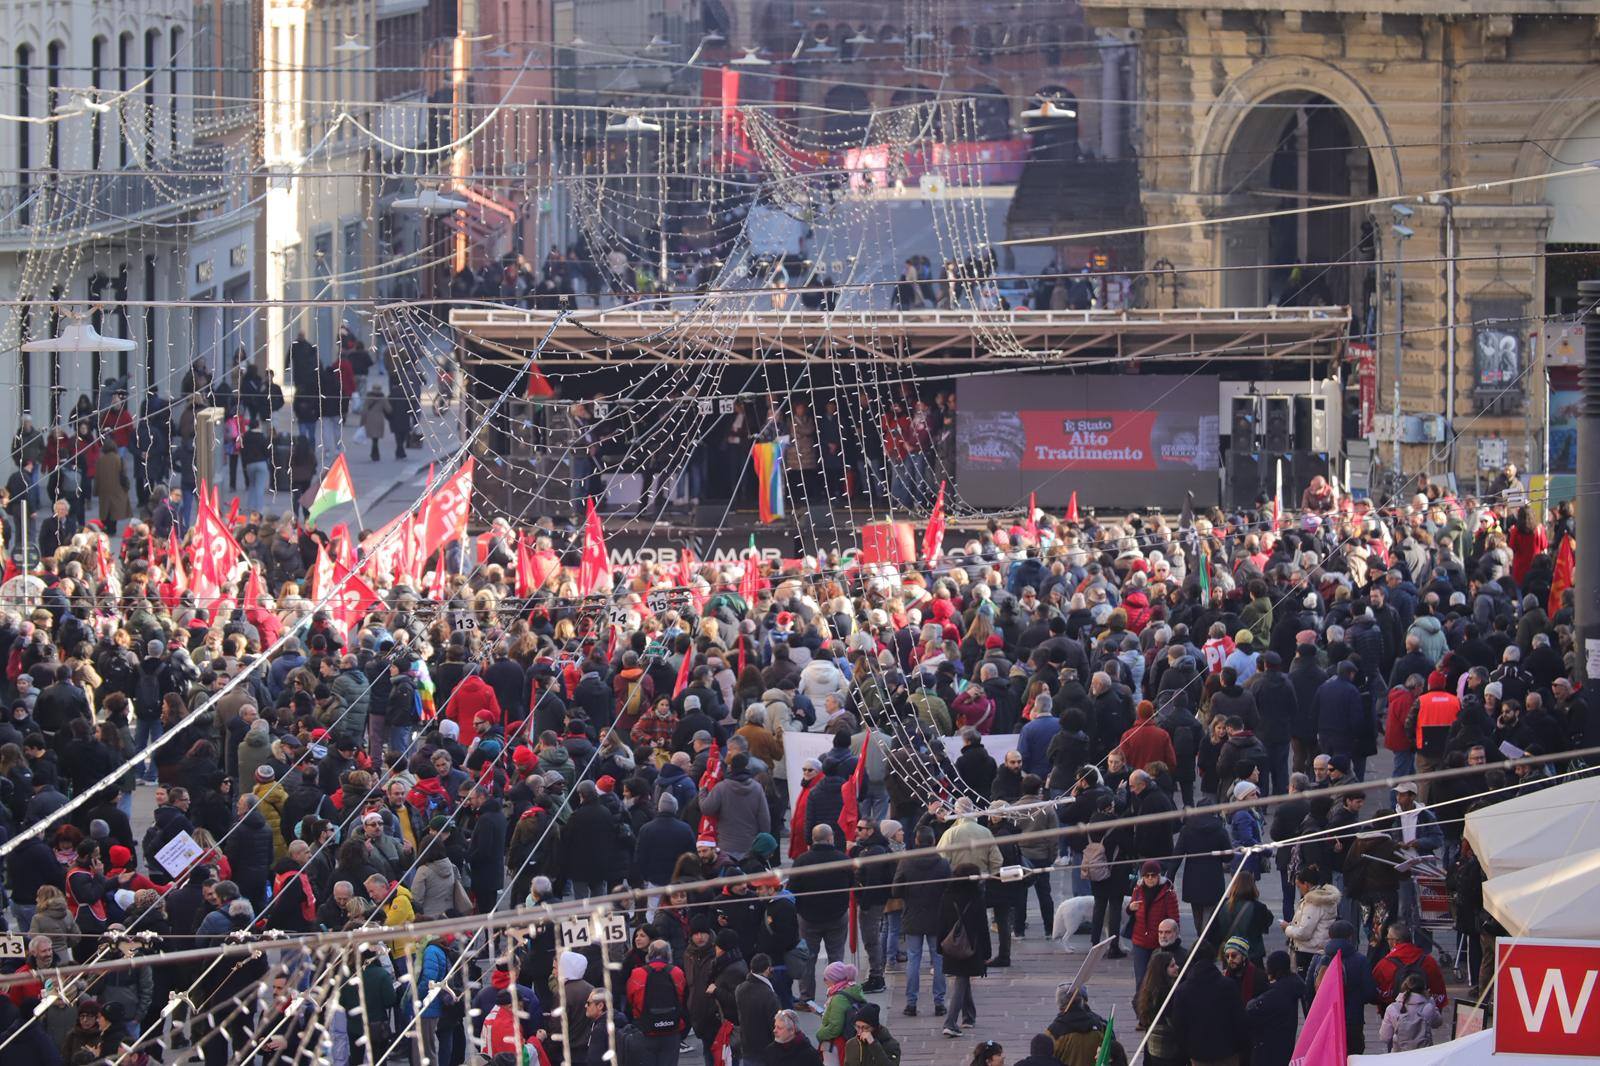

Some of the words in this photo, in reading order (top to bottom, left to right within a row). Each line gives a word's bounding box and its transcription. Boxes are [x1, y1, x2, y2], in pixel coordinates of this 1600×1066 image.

[1077, 420, 1112, 430] Stato
[1069, 431, 1109, 446] Alto
[1035, 445, 1143, 460] Tradimento
[609, 547, 677, 565] MOB
[650, 599, 666, 611] 15
[457, 618, 475, 630] 13
[610, 611, 627, 624] 14
[564, 927, 588, 943] 14
[603, 925, 624, 940] 15
[0, 942, 23, 955] 13
[1509, 967, 1599, 1034] W
[654, 1020, 674, 1028] adidas
